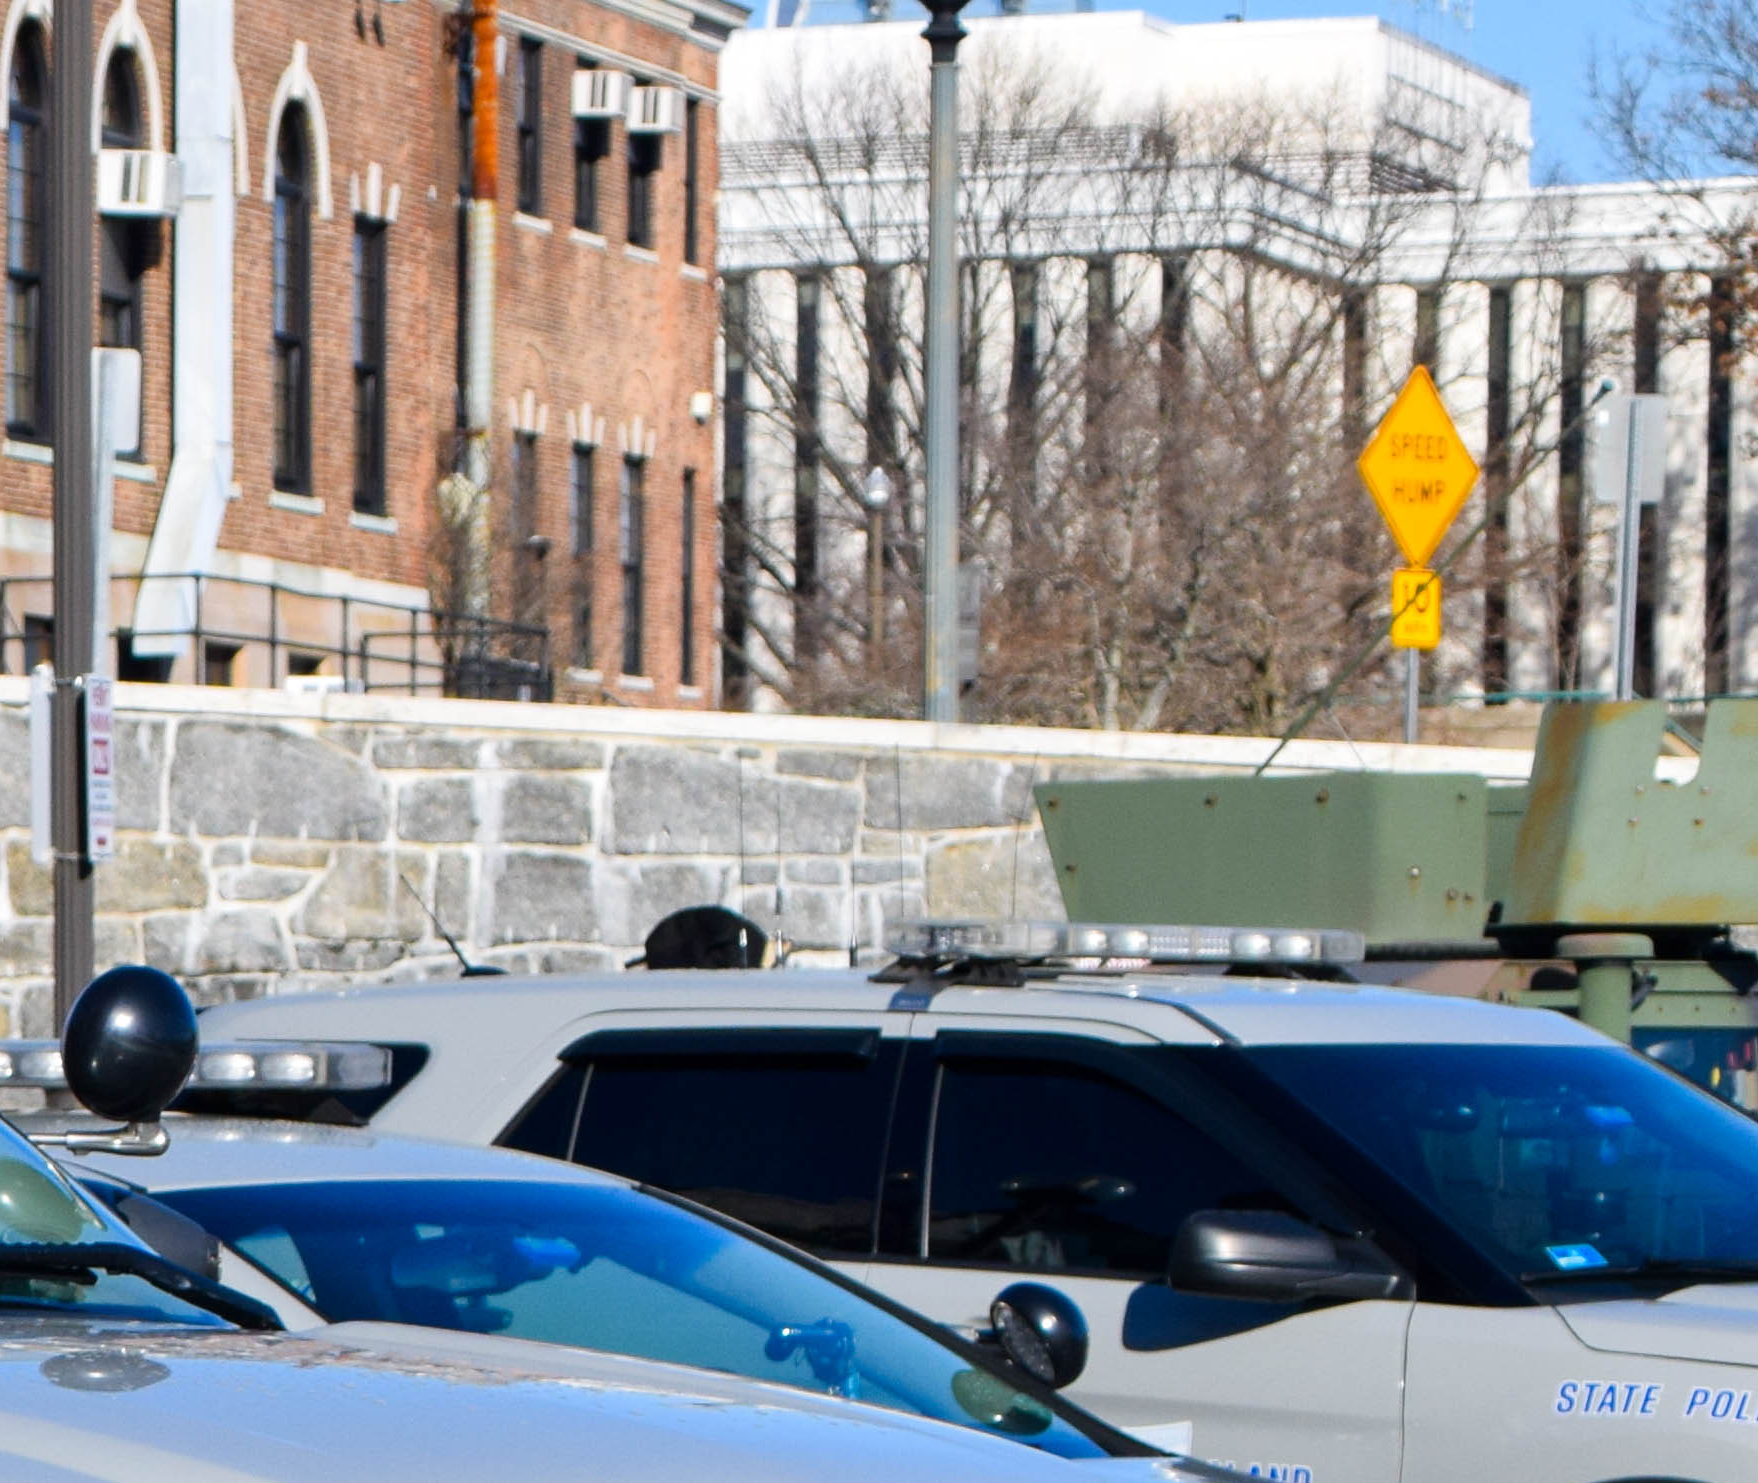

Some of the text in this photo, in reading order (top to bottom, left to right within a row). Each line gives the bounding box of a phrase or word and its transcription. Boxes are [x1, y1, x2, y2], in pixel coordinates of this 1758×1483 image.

[1391, 433, 1448, 460] SPEED
[1393, 479, 1445, 502] HUMP
[1556, 1381, 1758, 1423] STATE POL
